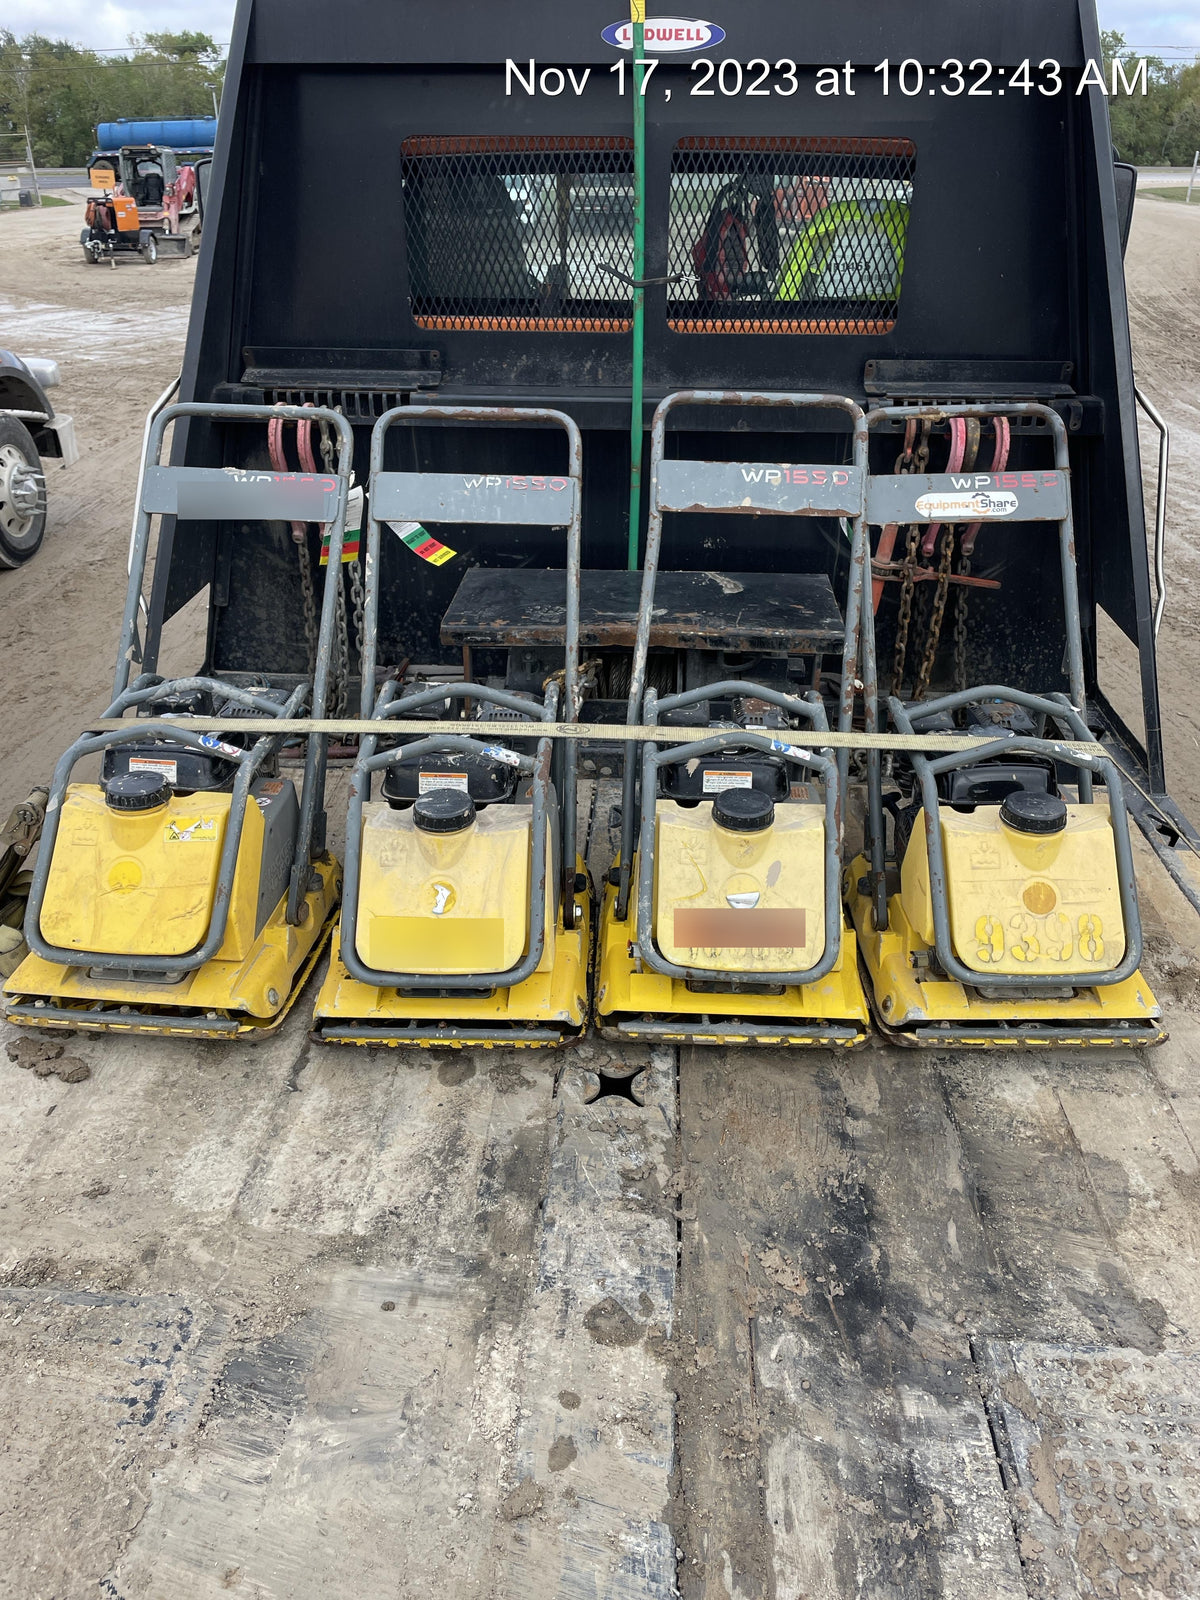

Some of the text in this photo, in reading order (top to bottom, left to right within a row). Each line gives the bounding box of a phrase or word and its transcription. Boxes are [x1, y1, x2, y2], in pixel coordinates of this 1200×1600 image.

[622, 28, 704, 41] LDWELL
[916, 497, 1018, 512] EquipmentShare
[975, 912, 1105, 963] 9398
